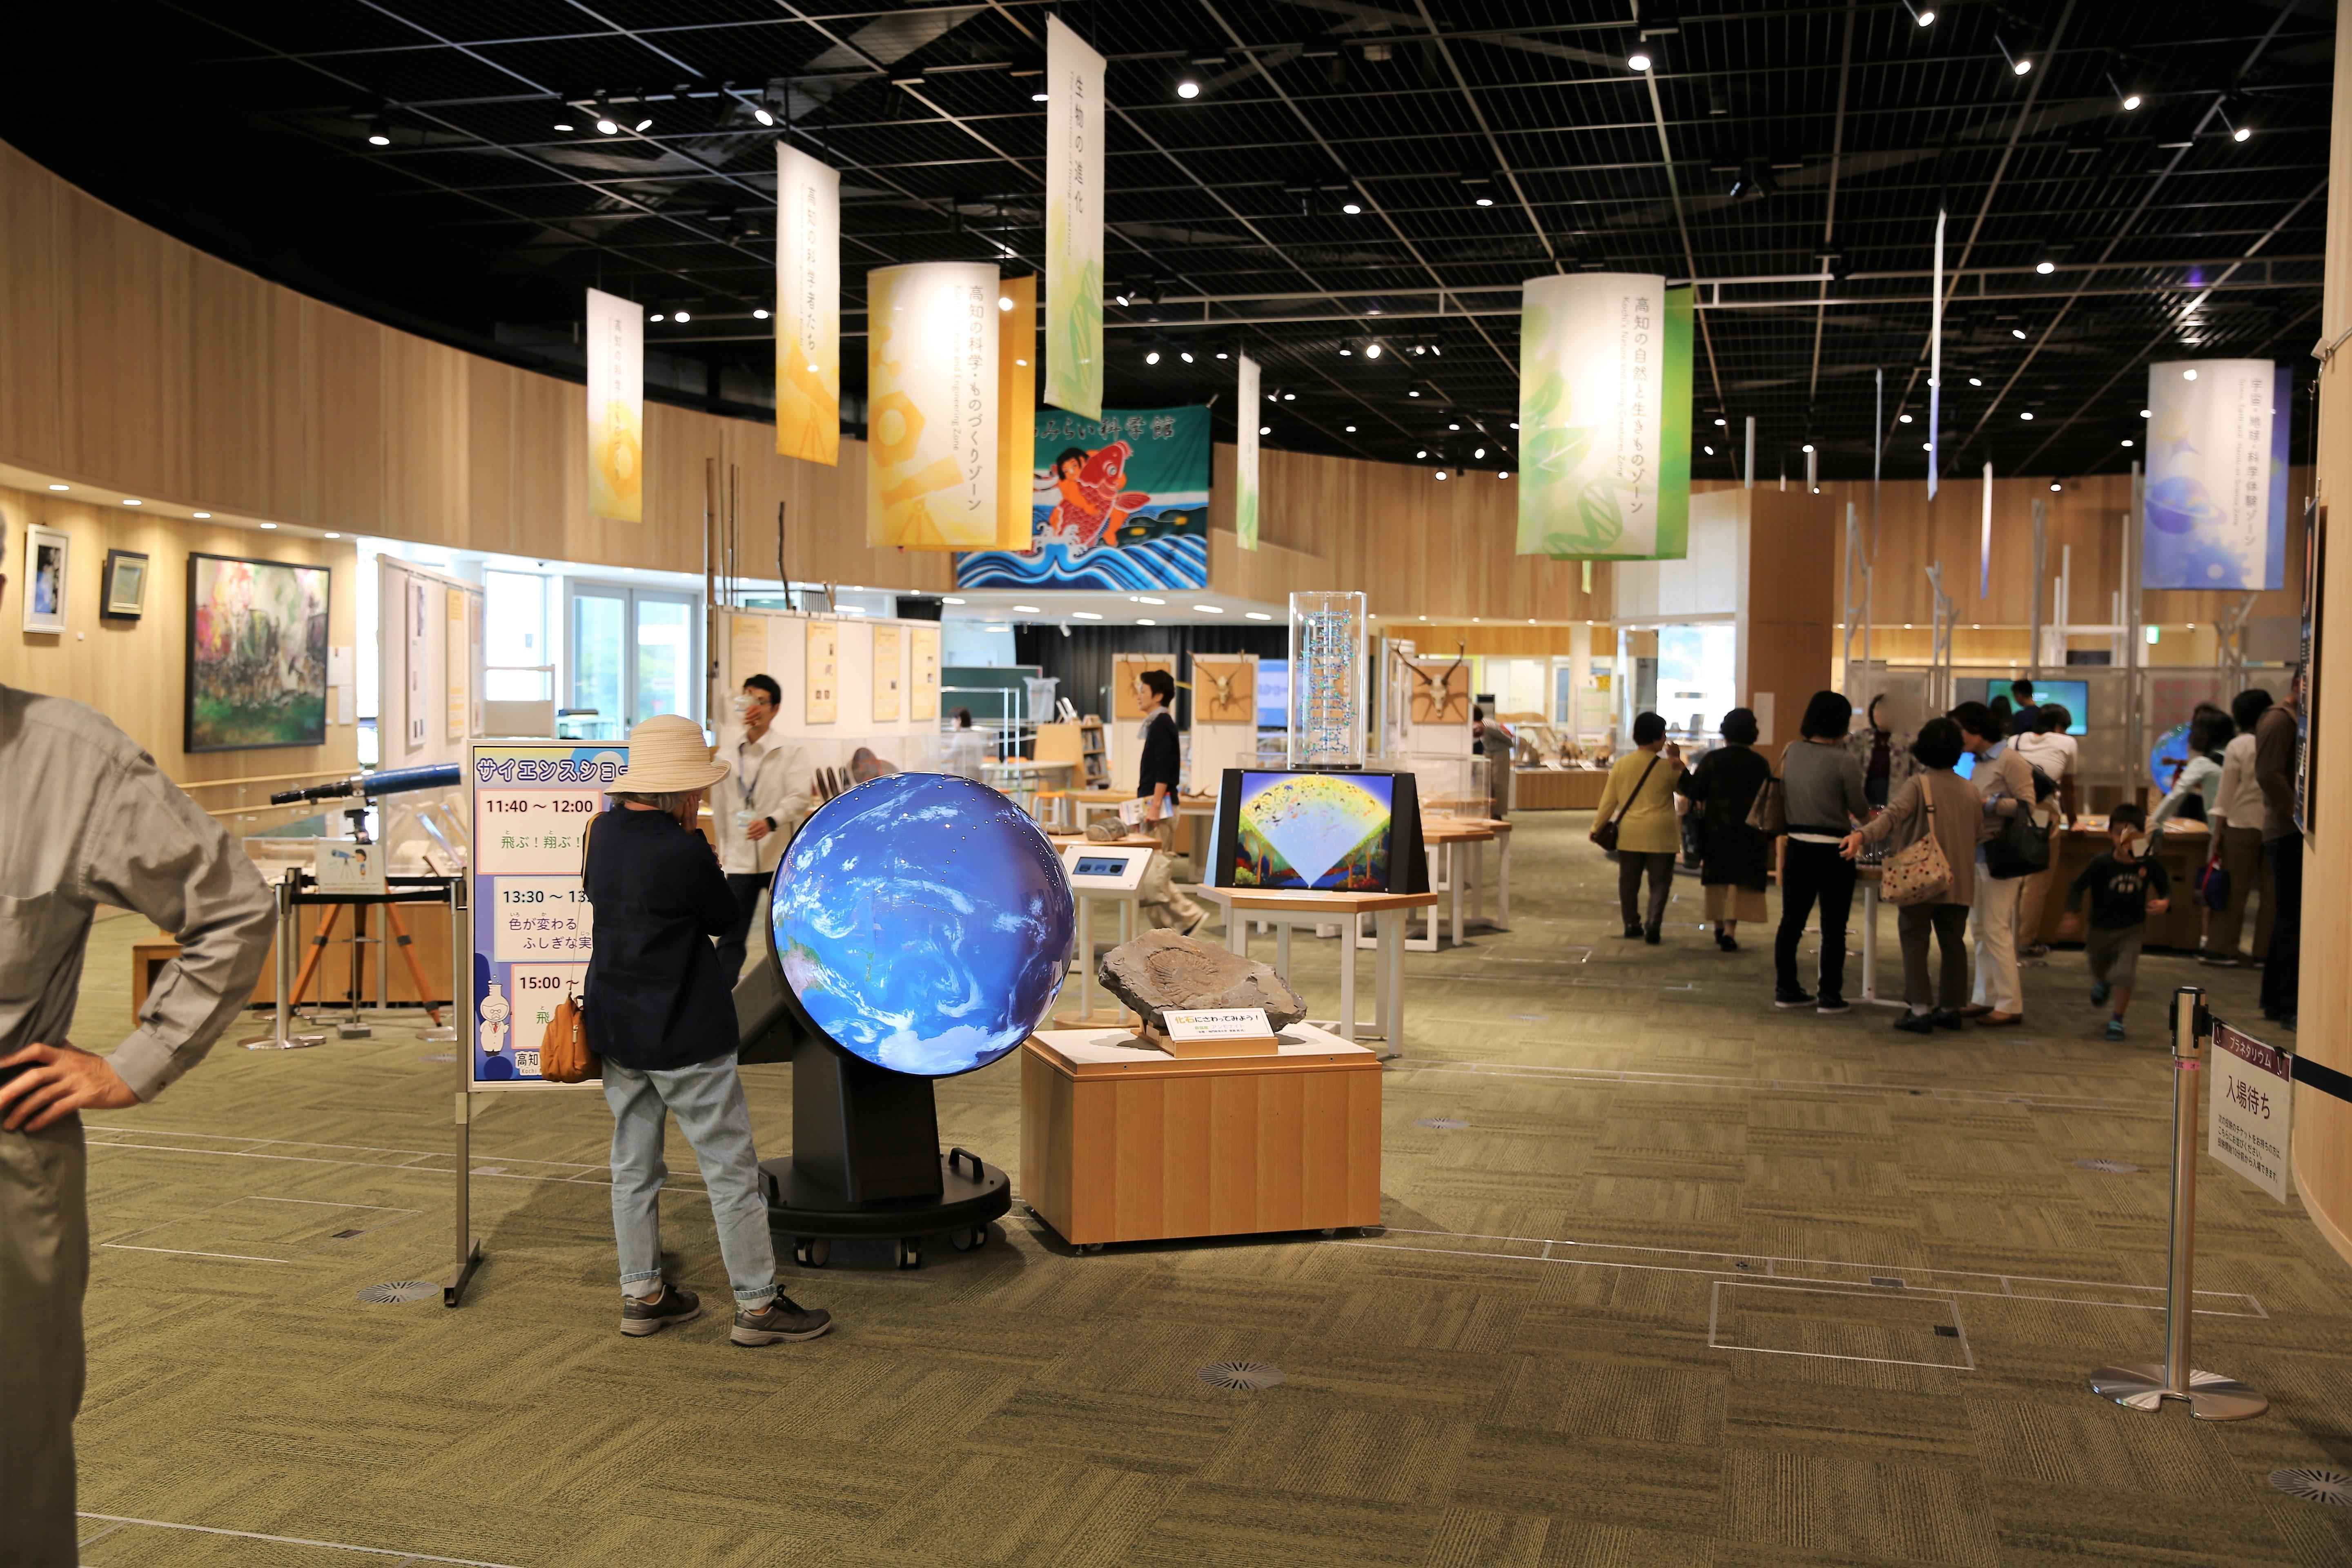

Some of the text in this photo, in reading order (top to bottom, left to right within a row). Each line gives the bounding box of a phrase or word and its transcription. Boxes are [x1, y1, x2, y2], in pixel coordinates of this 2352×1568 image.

[951, 375, 962, 426] Engineering
[968, 285, 984, 511] 高知の科学・ものづくりゾーン
[1631, 297, 1649, 514] 高知の自然と生きものゾーン
[1035, 416, 1176, 441] みらい科学館
[953, 429, 962, 451] Zone
[1617, 455, 1626, 477] Zone
[486, 800, 528, 813] 11:40
[552, 800, 593, 812] 12:00
[503, 891, 544, 903] 13:30
[509, 918, 577, 931] 色が変わる
[523, 936, 592, 949] ふしぎな実
[520, 976, 560, 989] 15:00
[536, 1011, 550, 1024] 飛
[1175, 1015, 1258, 1024] 化石にさわってみよう！
[517, 1054, 538, 1067] 高知
[2230, 1036, 2272, 1069] プラネタリウム
[2226, 1075, 2270, 1120] 入場待ち
